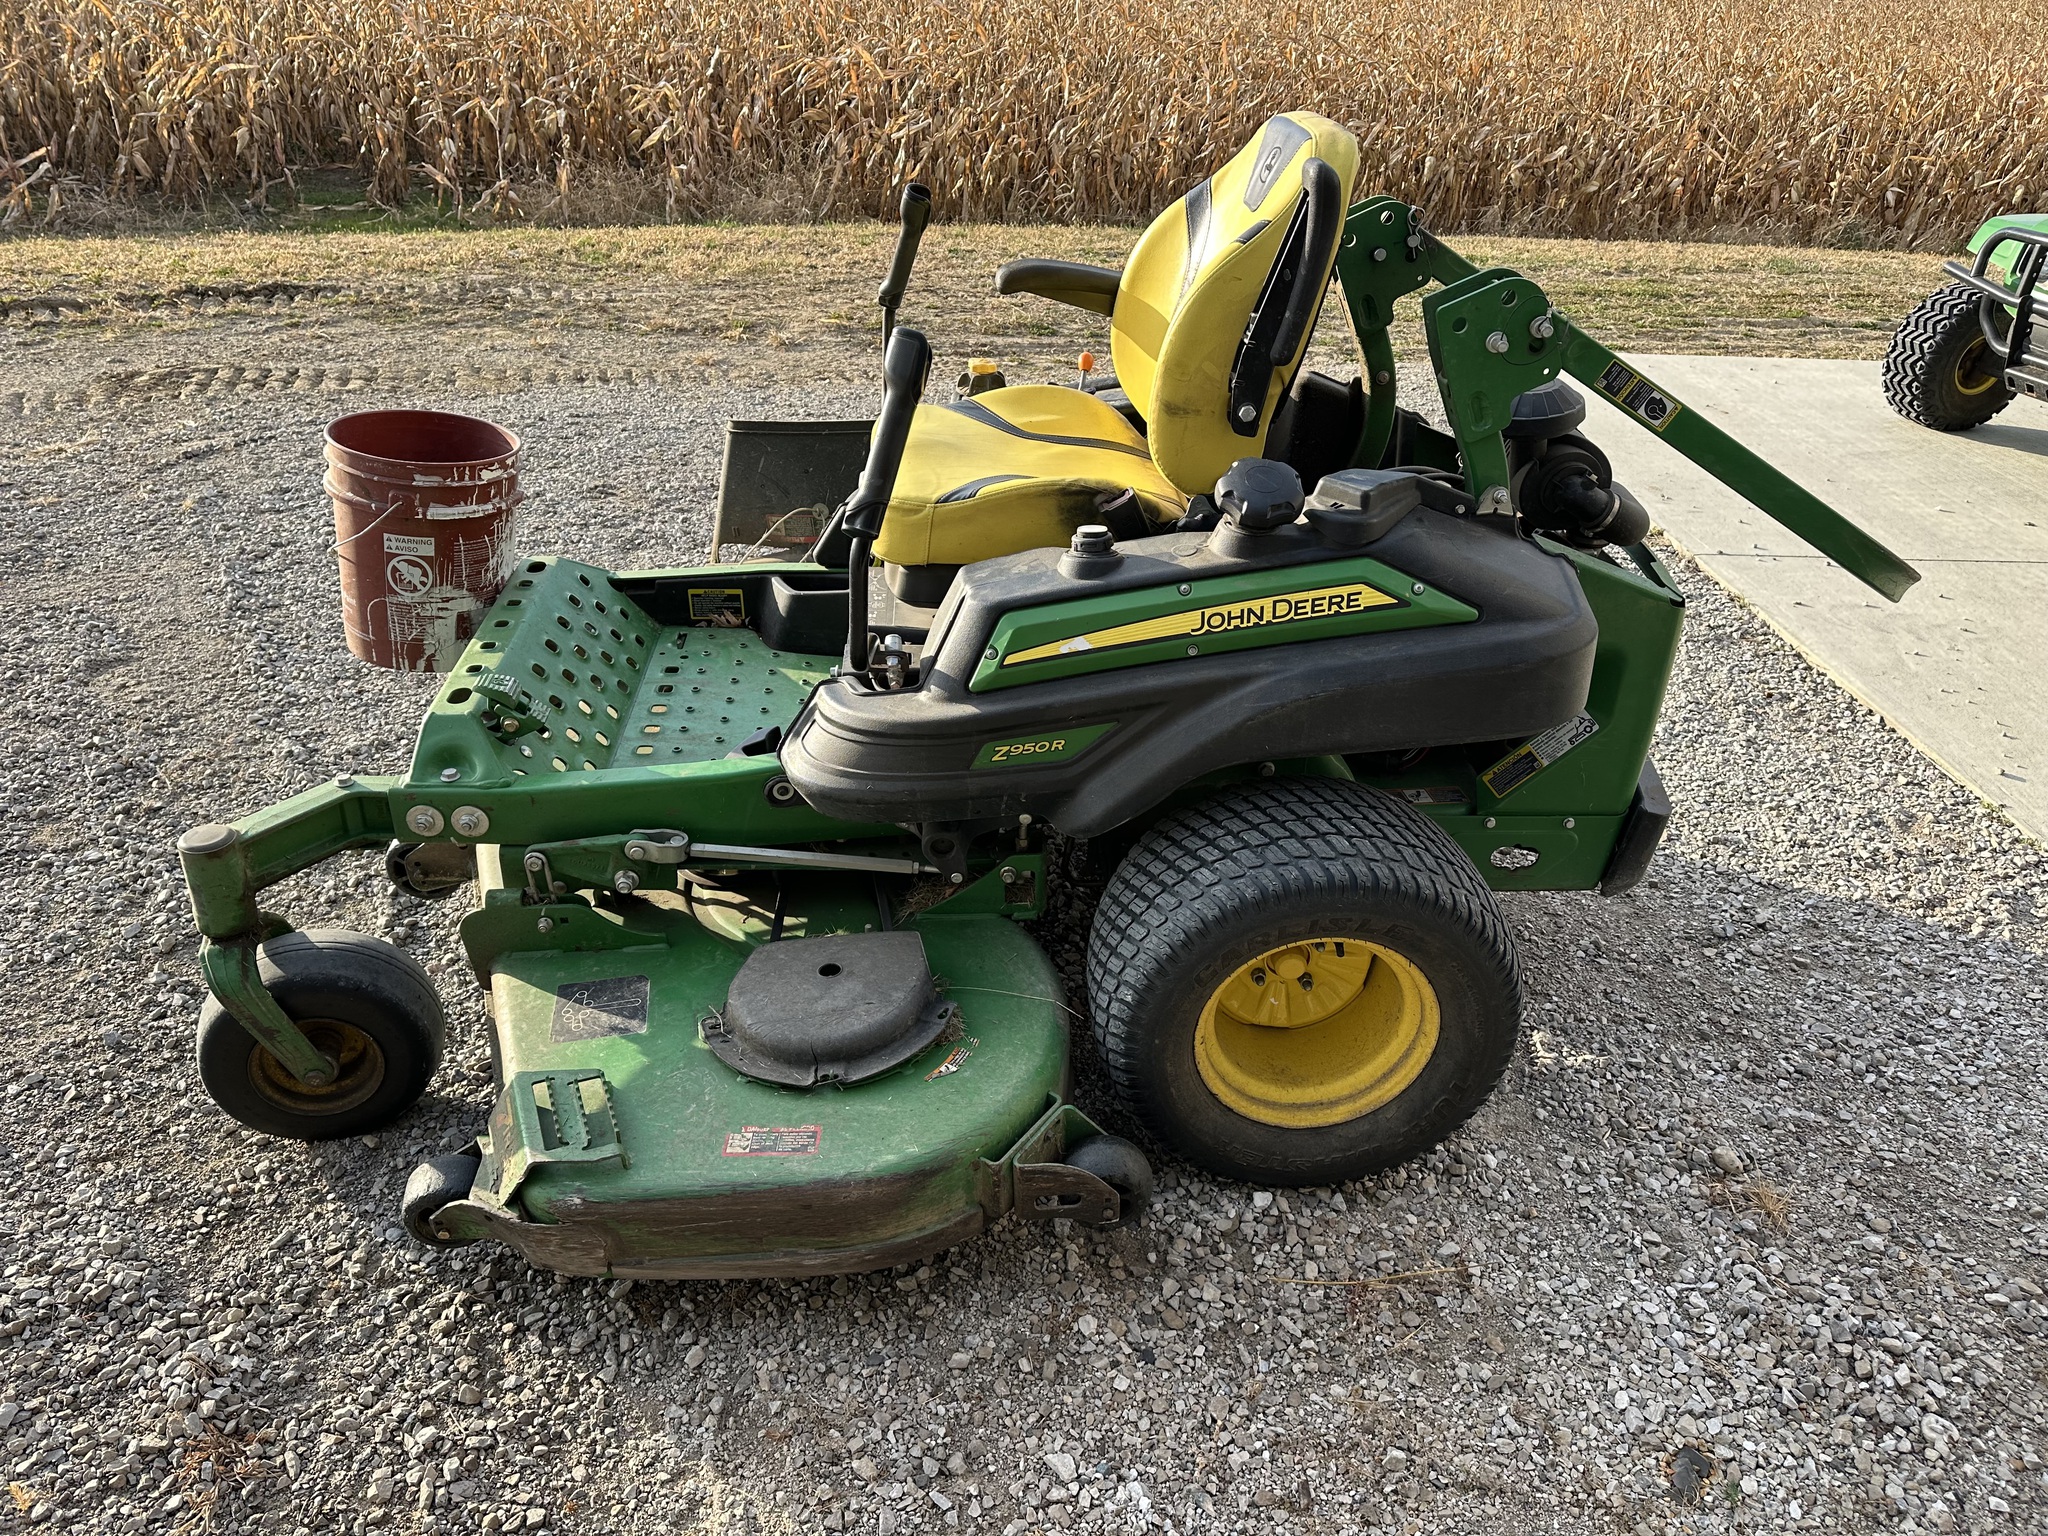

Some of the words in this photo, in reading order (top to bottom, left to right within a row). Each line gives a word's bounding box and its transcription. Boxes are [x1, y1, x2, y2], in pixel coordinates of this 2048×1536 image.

[394, 536, 433, 546] WARNING
[394, 545, 419, 553] AVISO
[1190, 602, 1265, 637] JOHN
[1271, 590, 1363, 624] DEERE
[1193, 917, 1418, 988] CARLISLE
